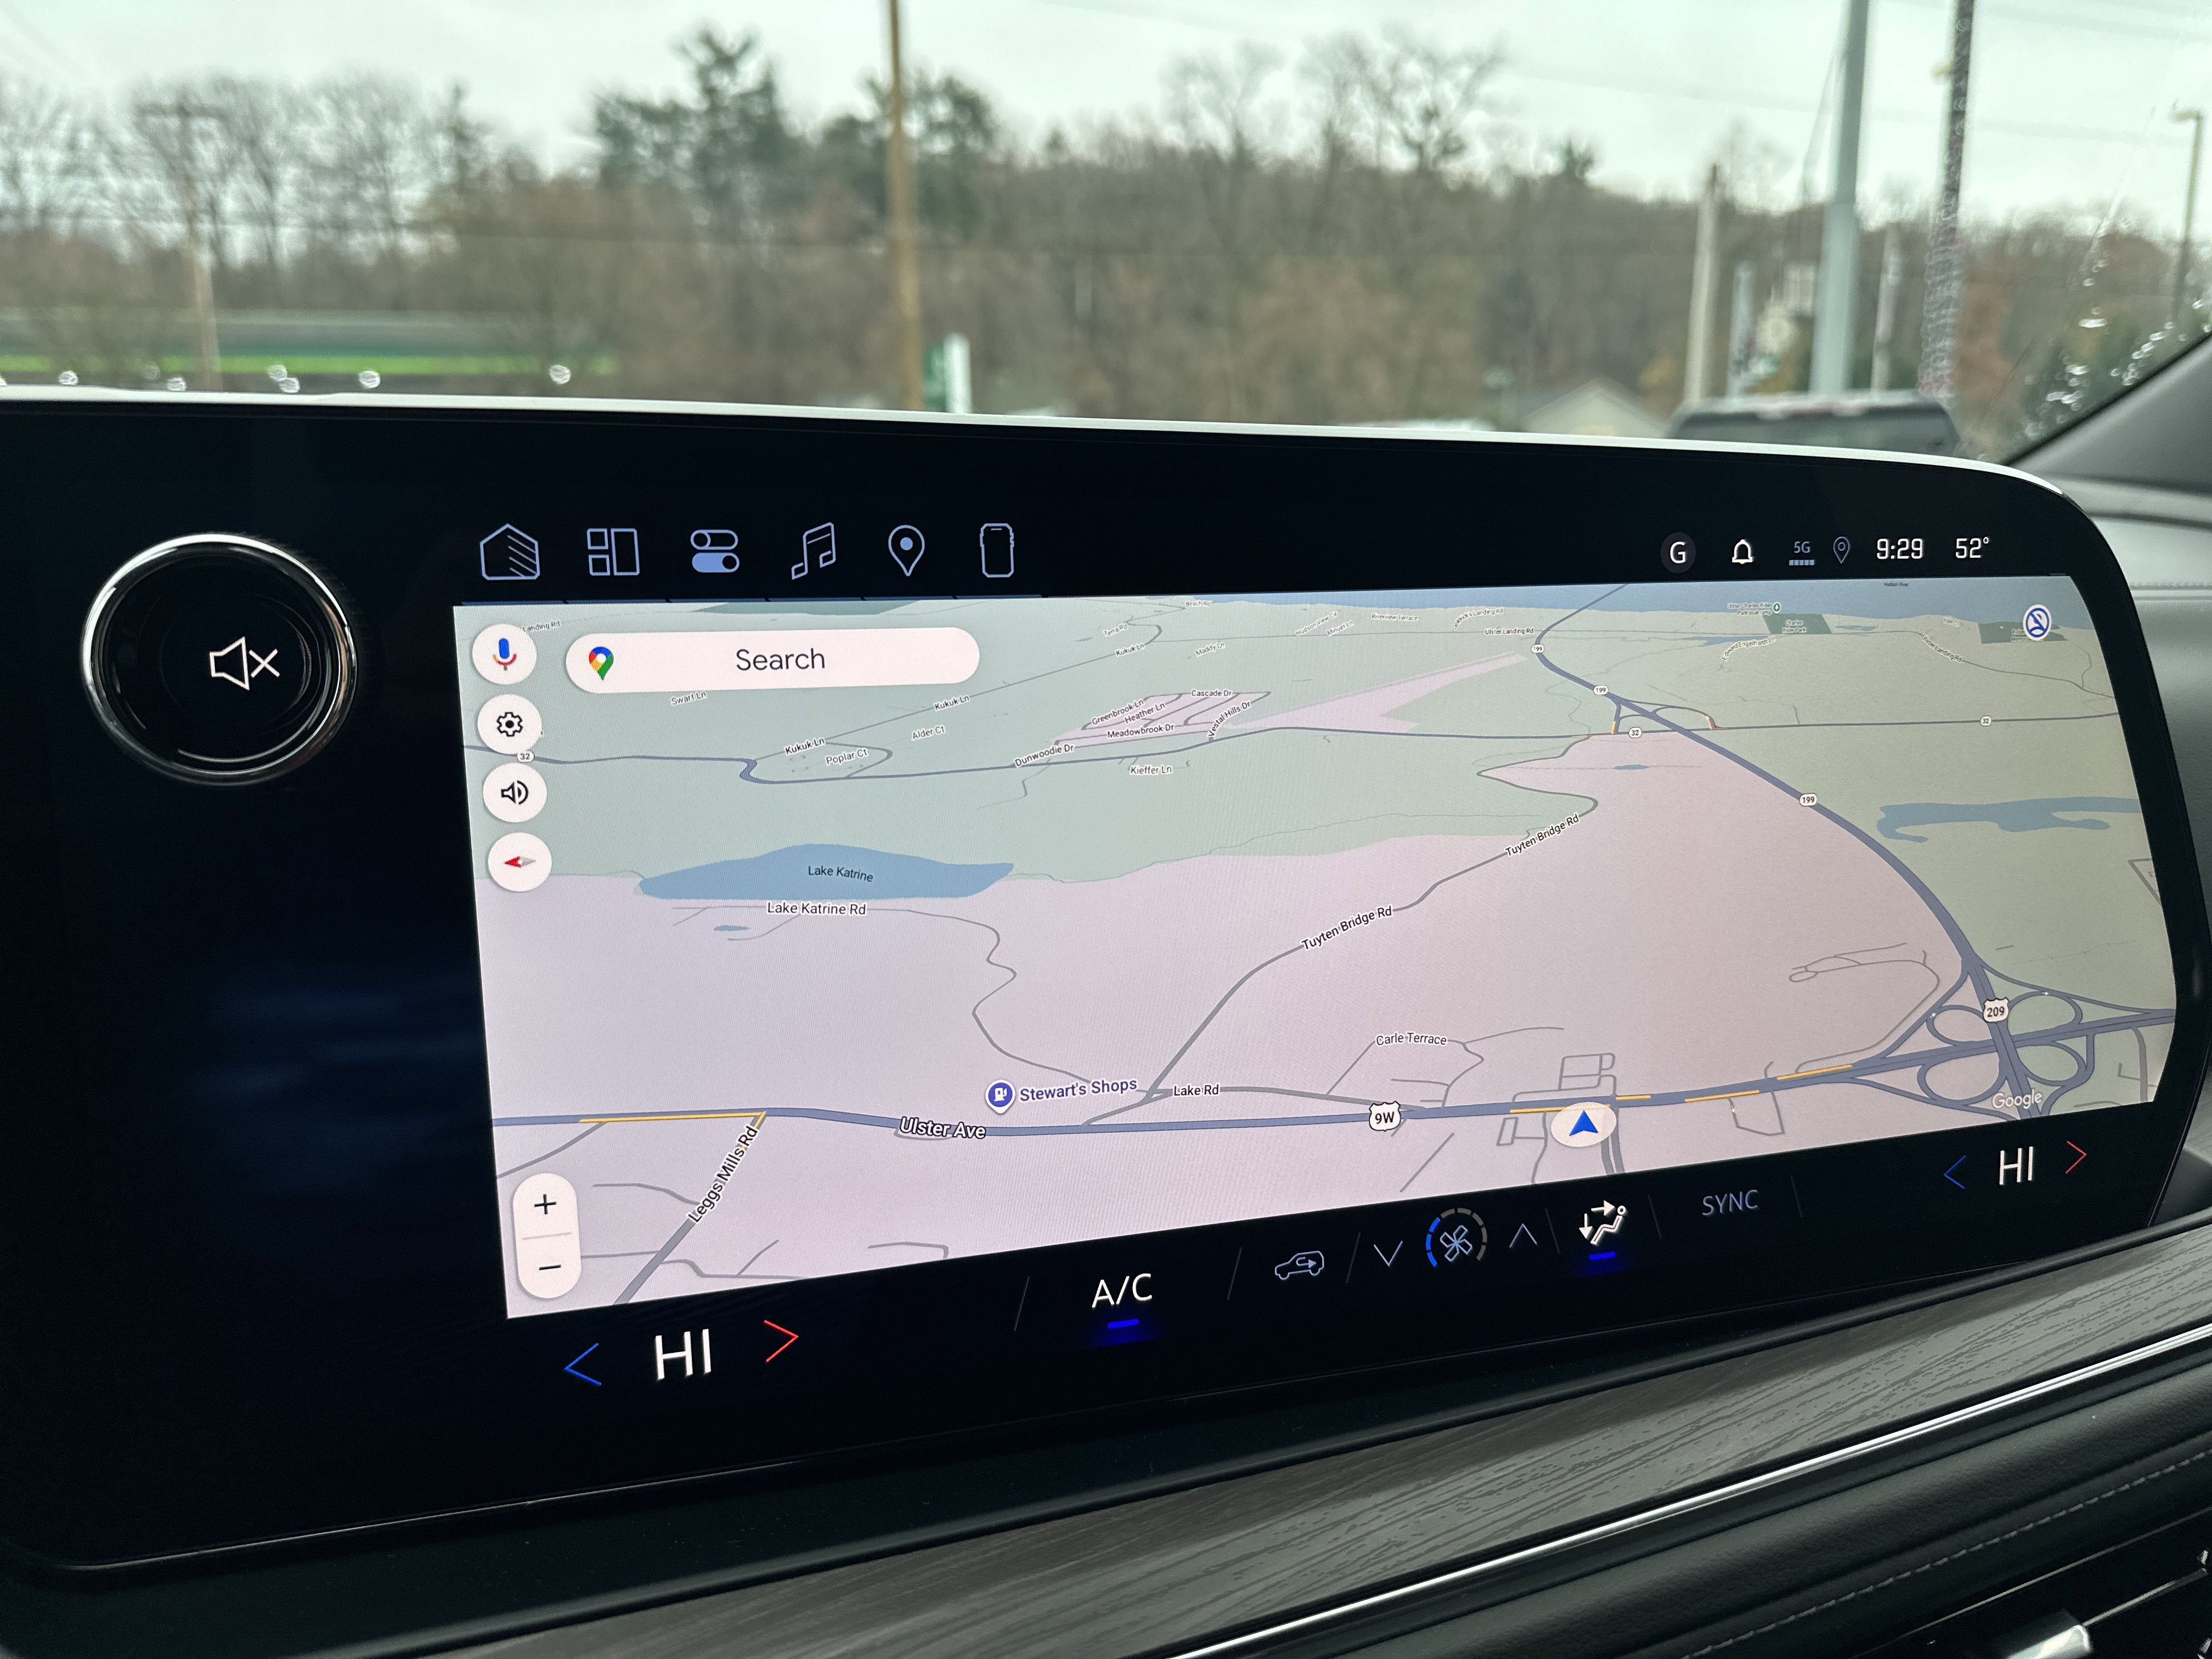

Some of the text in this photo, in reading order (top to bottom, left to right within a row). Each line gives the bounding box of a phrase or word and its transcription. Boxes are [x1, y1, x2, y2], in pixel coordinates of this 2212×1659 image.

[1670, 541, 1686, 563] G
[1794, 541, 1810, 554] 5G
[1877, 538, 1923, 560] 9:29
[1955, 537, 1990, 559] 52°
[1104, 628, 1119, 636] Terra
[1296, 623, 1317, 635] Hudson
[1317, 616, 1329, 625] View
[1116, 646, 1136, 656] Kukuk
[1196, 645, 1216, 656] Maddy
[1722, 644, 1739, 661] Edward
[1739, 639, 1768, 648] Engelhardt
[1922, 634, 1935, 647] Ulster
[1935, 645, 1954, 660] Landing
[736, 648, 826, 670] Search
[671, 691, 706, 705] Swart Ln
[934, 695, 969, 710] Kukuk Ln
[1092, 699, 1144, 725] Greenbrook Ln
[1125, 702, 1165, 724] Heather Ln
[1208, 701, 1251, 737] Vestal Hills Dr
[912, 726, 945, 740] Alder Ct
[1107, 726, 1164, 738] Meadowbrook
[785, 737, 825, 755] Kukuk Ln
[1015, 744, 1074, 766] Dunwoodie Dr
[826, 749, 868, 765] Poplar Ct
[1130, 766, 1160, 774] Kieffer
[1802, 796, 1815, 804] 199
[1505, 814, 1579, 856] Tuyten Bridge Rd
[808, 865, 874, 883] Lake Katrine
[768, 901, 866, 915] Lake Katrine Rd
[1301, 905, 1392, 951] Tuyten Bridge Rd
[1987, 1005, 2005, 1019] 209
[1375, 1032, 1447, 1046] Carle Terrace
[1020, 1079, 1137, 1102] Stewart's Shops
[1173, 1084, 1220, 1097] Lake Rd
[1992, 1090, 2042, 1110] Google
[900, 1116, 986, 1139] Ulster Ave
[1374, 1111, 1395, 1125] 9W
[688, 1124, 759, 1223] Leggs Mills Rd
[2000, 1146, 2034, 1186] HI
[1702, 1189, 1758, 1217] SYNC
[1092, 1272, 1153, 1308] A/C
[655, 1328, 712, 1381] HI
